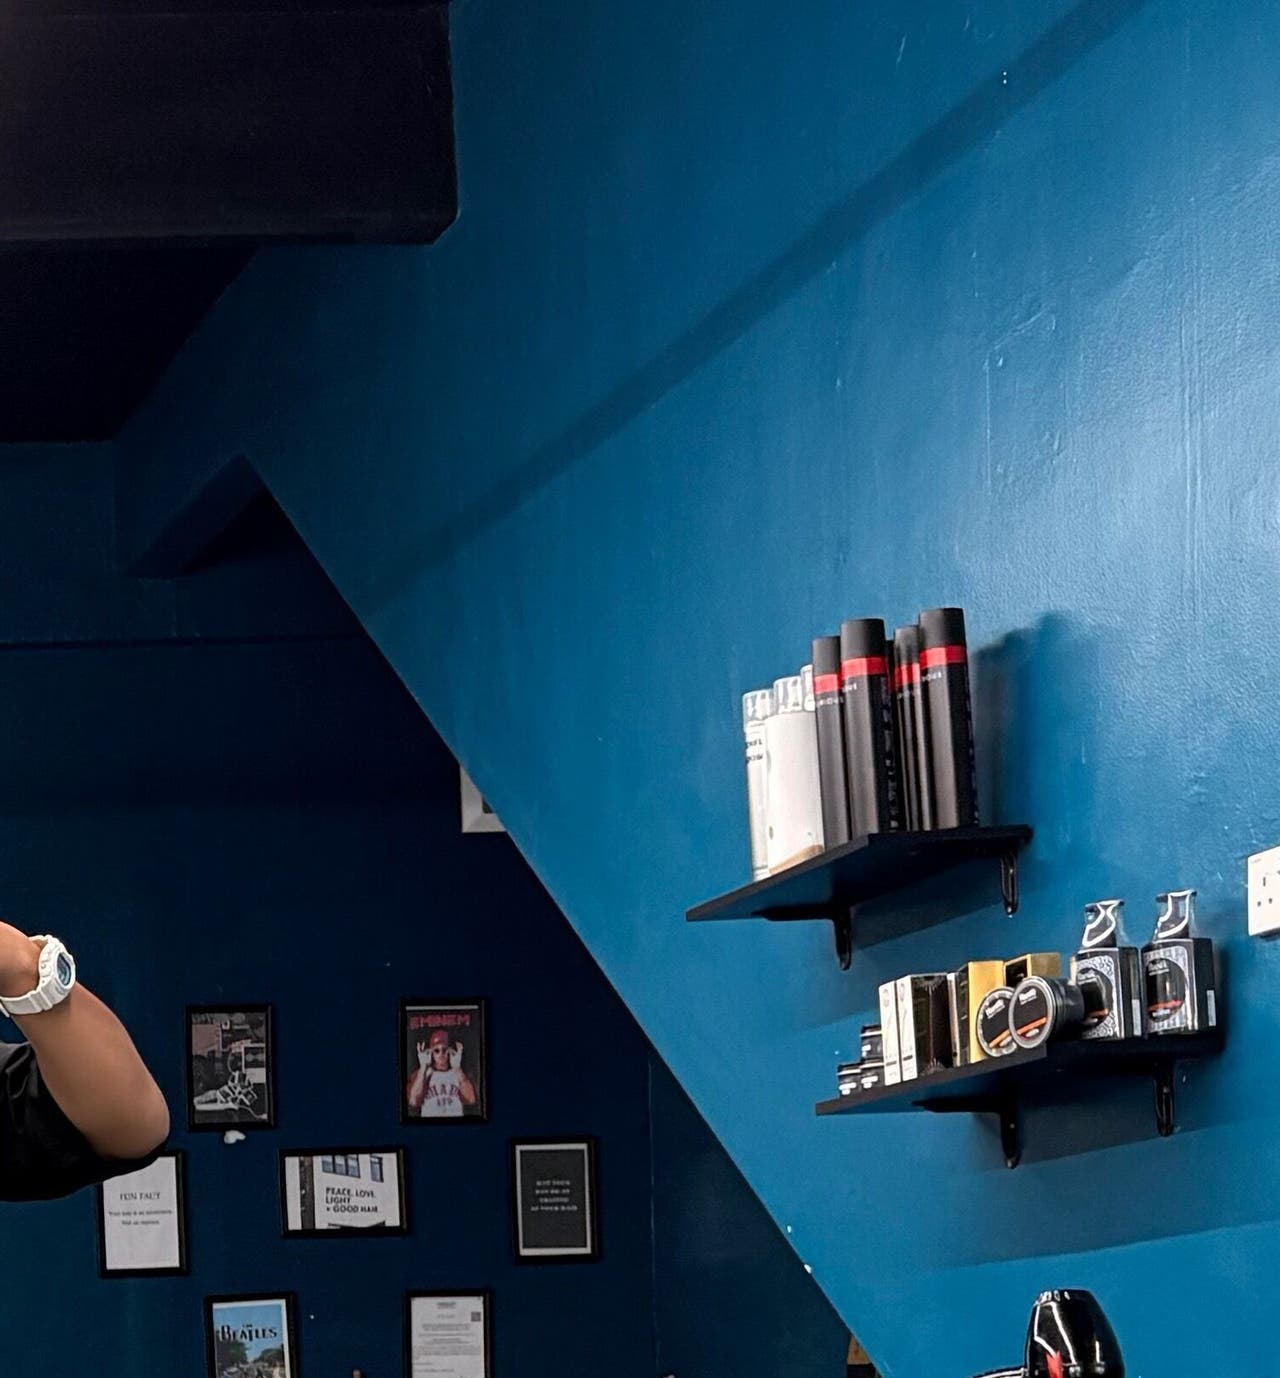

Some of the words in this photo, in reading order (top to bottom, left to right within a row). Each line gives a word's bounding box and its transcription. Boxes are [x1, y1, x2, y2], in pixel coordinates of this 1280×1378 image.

[326, 1196, 351, 1204] LIGHT
[333, 1205, 359, 1213] GOOD
[221, 1324, 277, 1341] BEATLES
